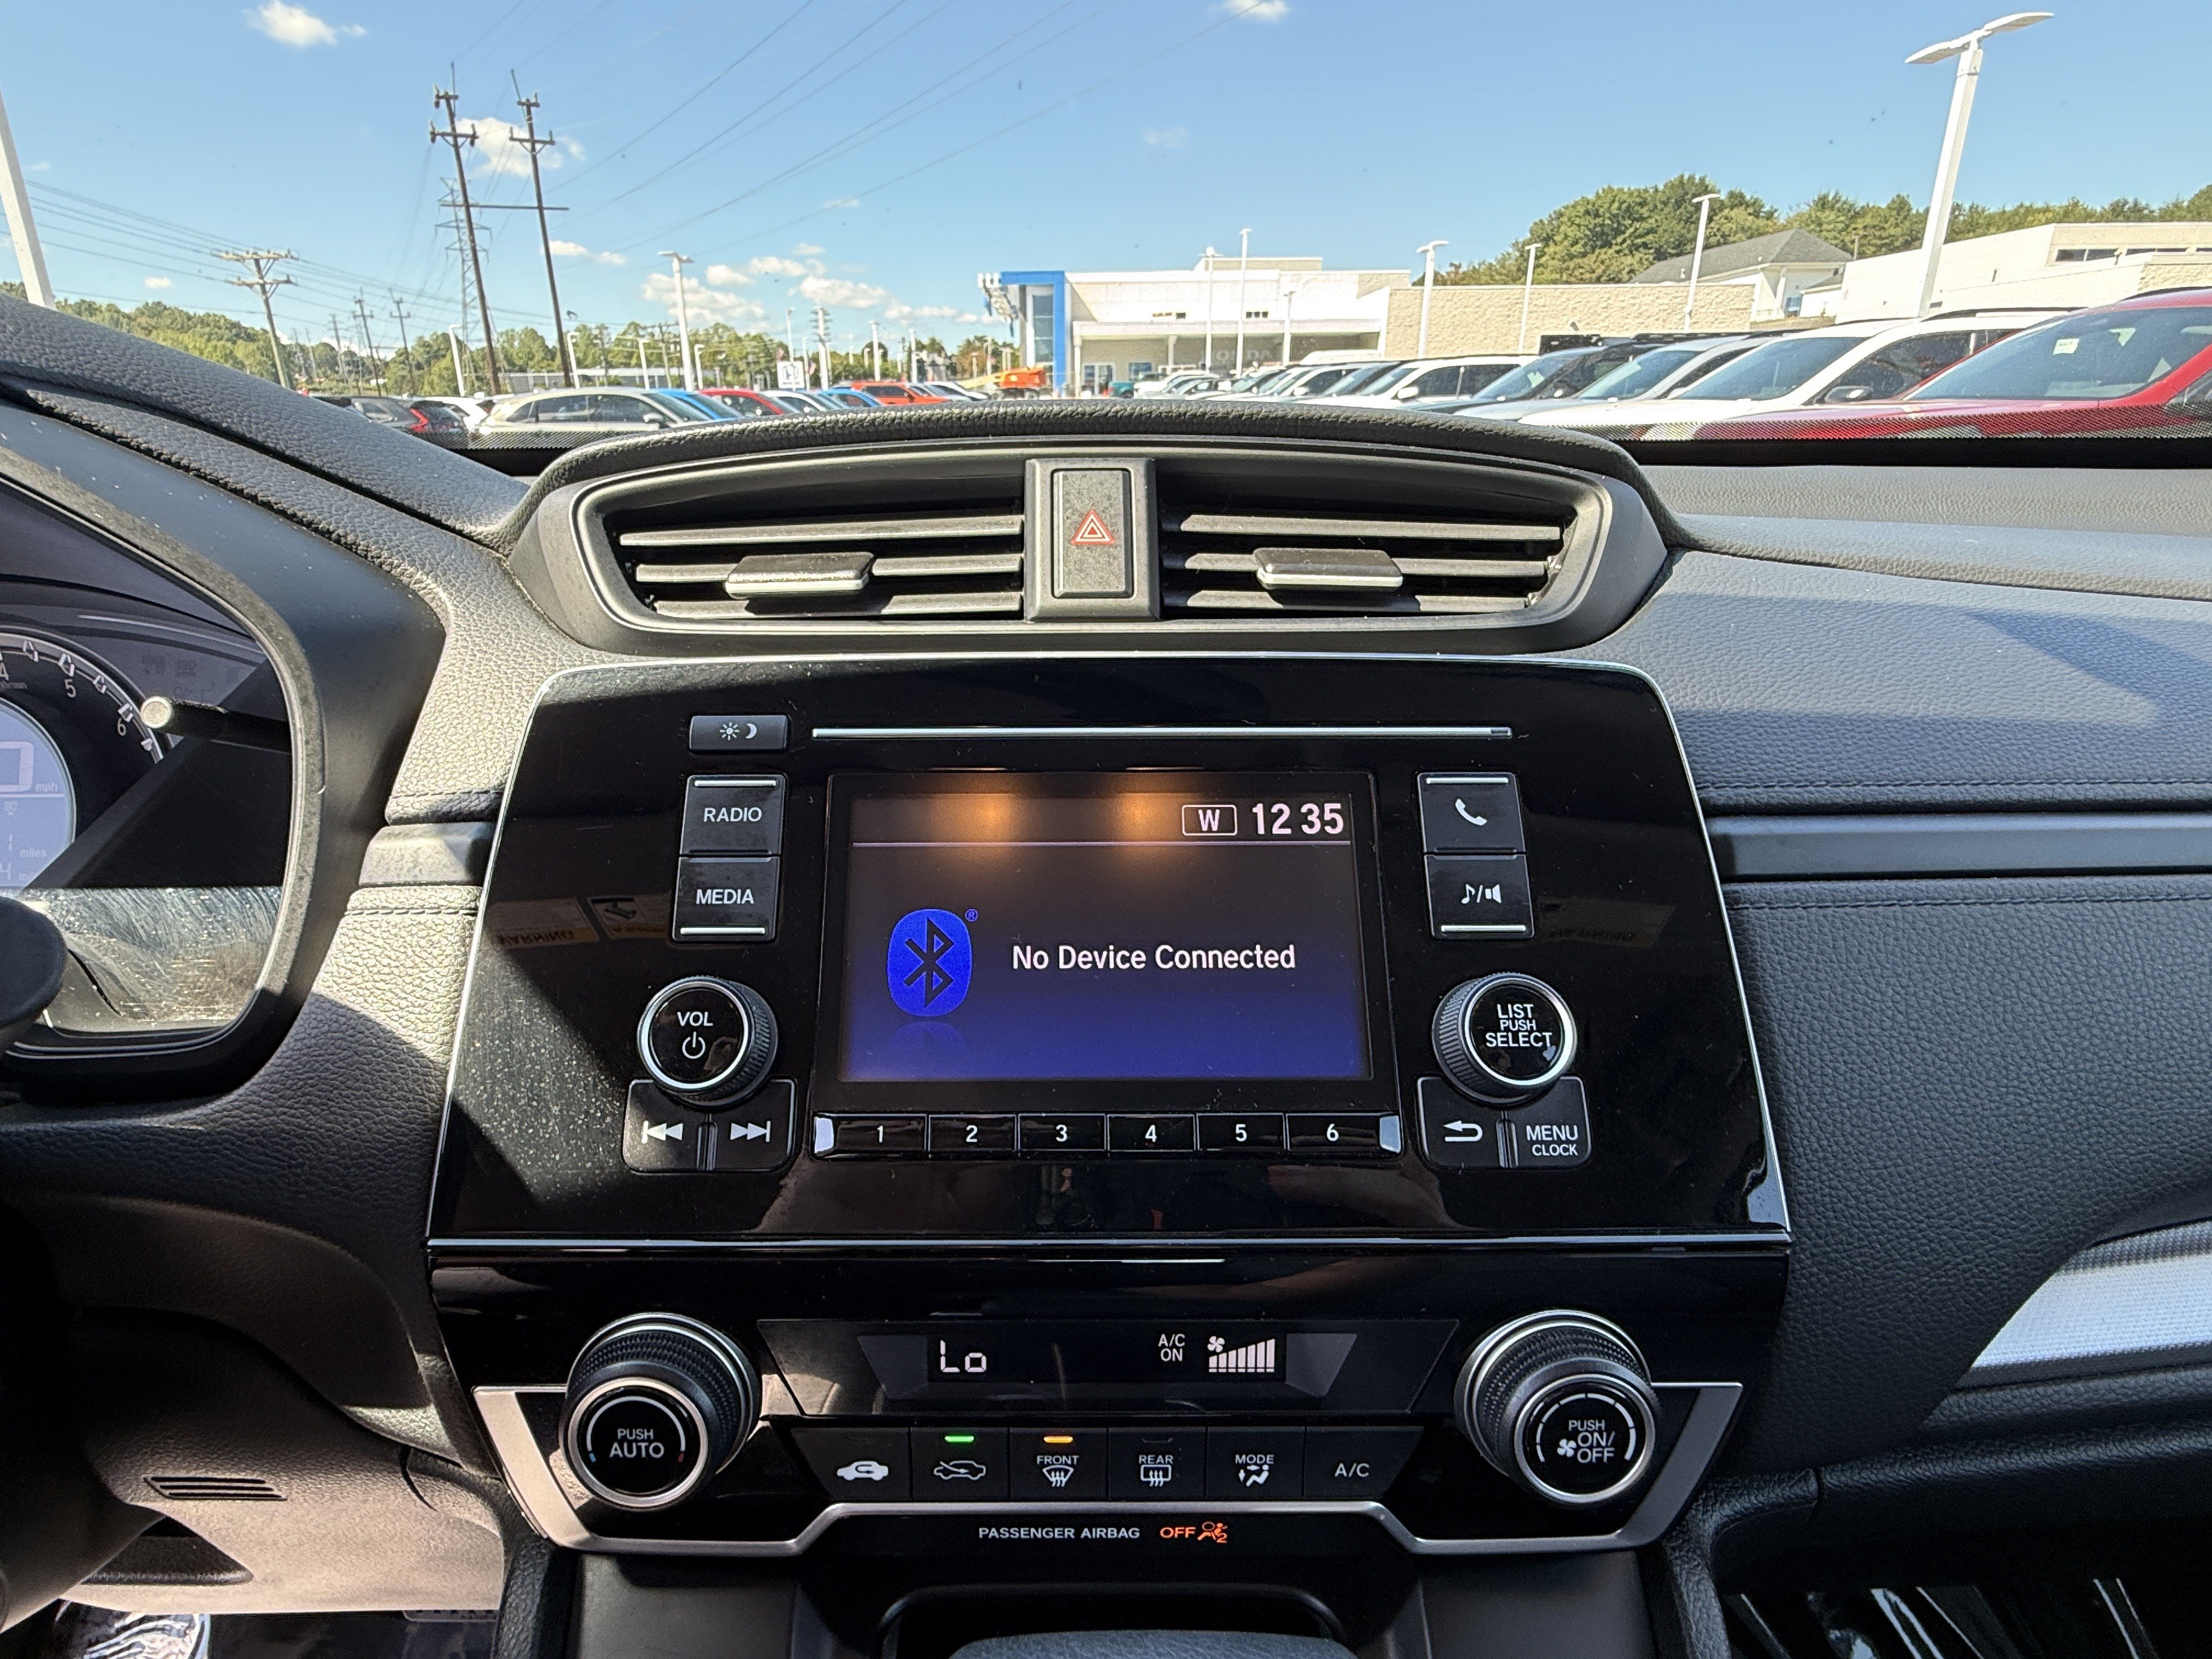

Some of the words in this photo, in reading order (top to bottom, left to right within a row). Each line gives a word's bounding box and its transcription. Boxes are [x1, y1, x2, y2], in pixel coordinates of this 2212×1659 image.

[64, 679, 77, 698] 5
[117, 717, 127, 736] 6
[35, 782, 58, 792] mph
[703, 806, 762, 822] RADIO
[1198, 809, 1220, 832] W
[696, 889, 755, 905] MEDIA
[1013, 945, 1049, 969] No
[1059, 945, 1147, 969] Device
[1155, 944, 1296, 969] Connected
[677, 1011, 713, 1026] VOL
[1497, 1003, 1534, 1019] LIST
[1500, 1020, 1537, 1031] PUSH
[1485, 1032, 1553, 1047] SELECT
[877, 1125, 883, 1143] 1
[966, 1125, 978, 1142] 2
[1056, 1124, 1068, 1142] 3
[1144, 1125, 1157, 1142] 4
[1235, 1124, 1248, 1142] 5
[1327, 1124, 1339, 1142] 6
[1526, 1125, 1578, 1141] MENU
[1532, 1143, 1578, 1156] CLOCK
[1158, 1333, 1185, 1348] A/C
[1160, 1348, 1183, 1362] ON
[1568, 1419, 1605, 1431] PUSH
[617, 1428, 654, 1440] PUSH
[1577, 1431, 1615, 1447] ON/
[610, 1442, 664, 1458] AUTO
[1577, 1447, 1615, 1464] OFF
[1036, 1455, 1079, 1465] FRONT
[1138, 1455, 1173, 1464] REAR
[1235, 1454, 1274, 1464] MODE
[1334, 1463, 1369, 1477] A/C
[979, 1527, 1075, 1539] PASSENGER
[1081, 1527, 1140, 1538] AIRBAG
[1160, 1526, 1197, 1538] OFF
